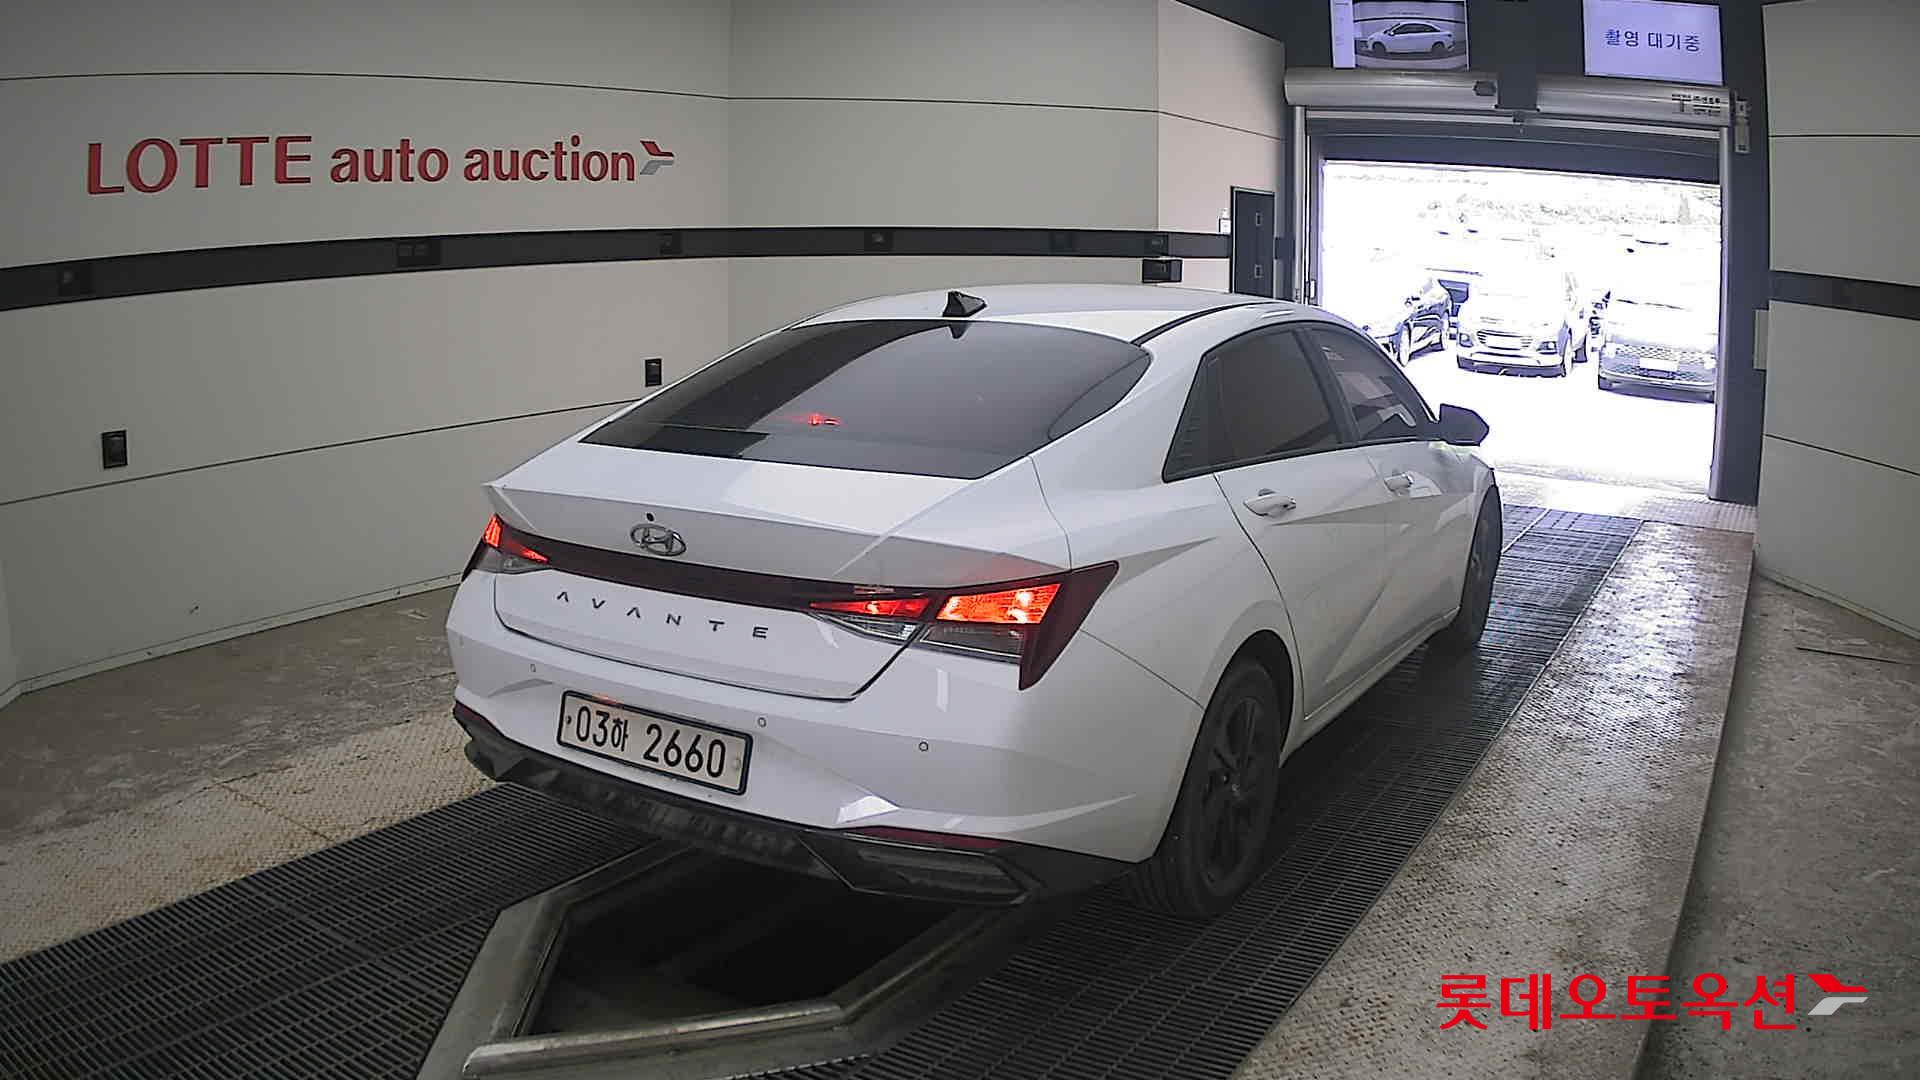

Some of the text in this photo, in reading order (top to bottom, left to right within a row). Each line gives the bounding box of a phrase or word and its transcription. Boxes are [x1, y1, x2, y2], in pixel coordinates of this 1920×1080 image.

[1647, 32, 1701, 52] 대기중
[88, 134, 636, 195] LOTTE auto auction
[556, 590, 769, 640] AVANTE
[576, 706, 727, 778] 03하 2660
